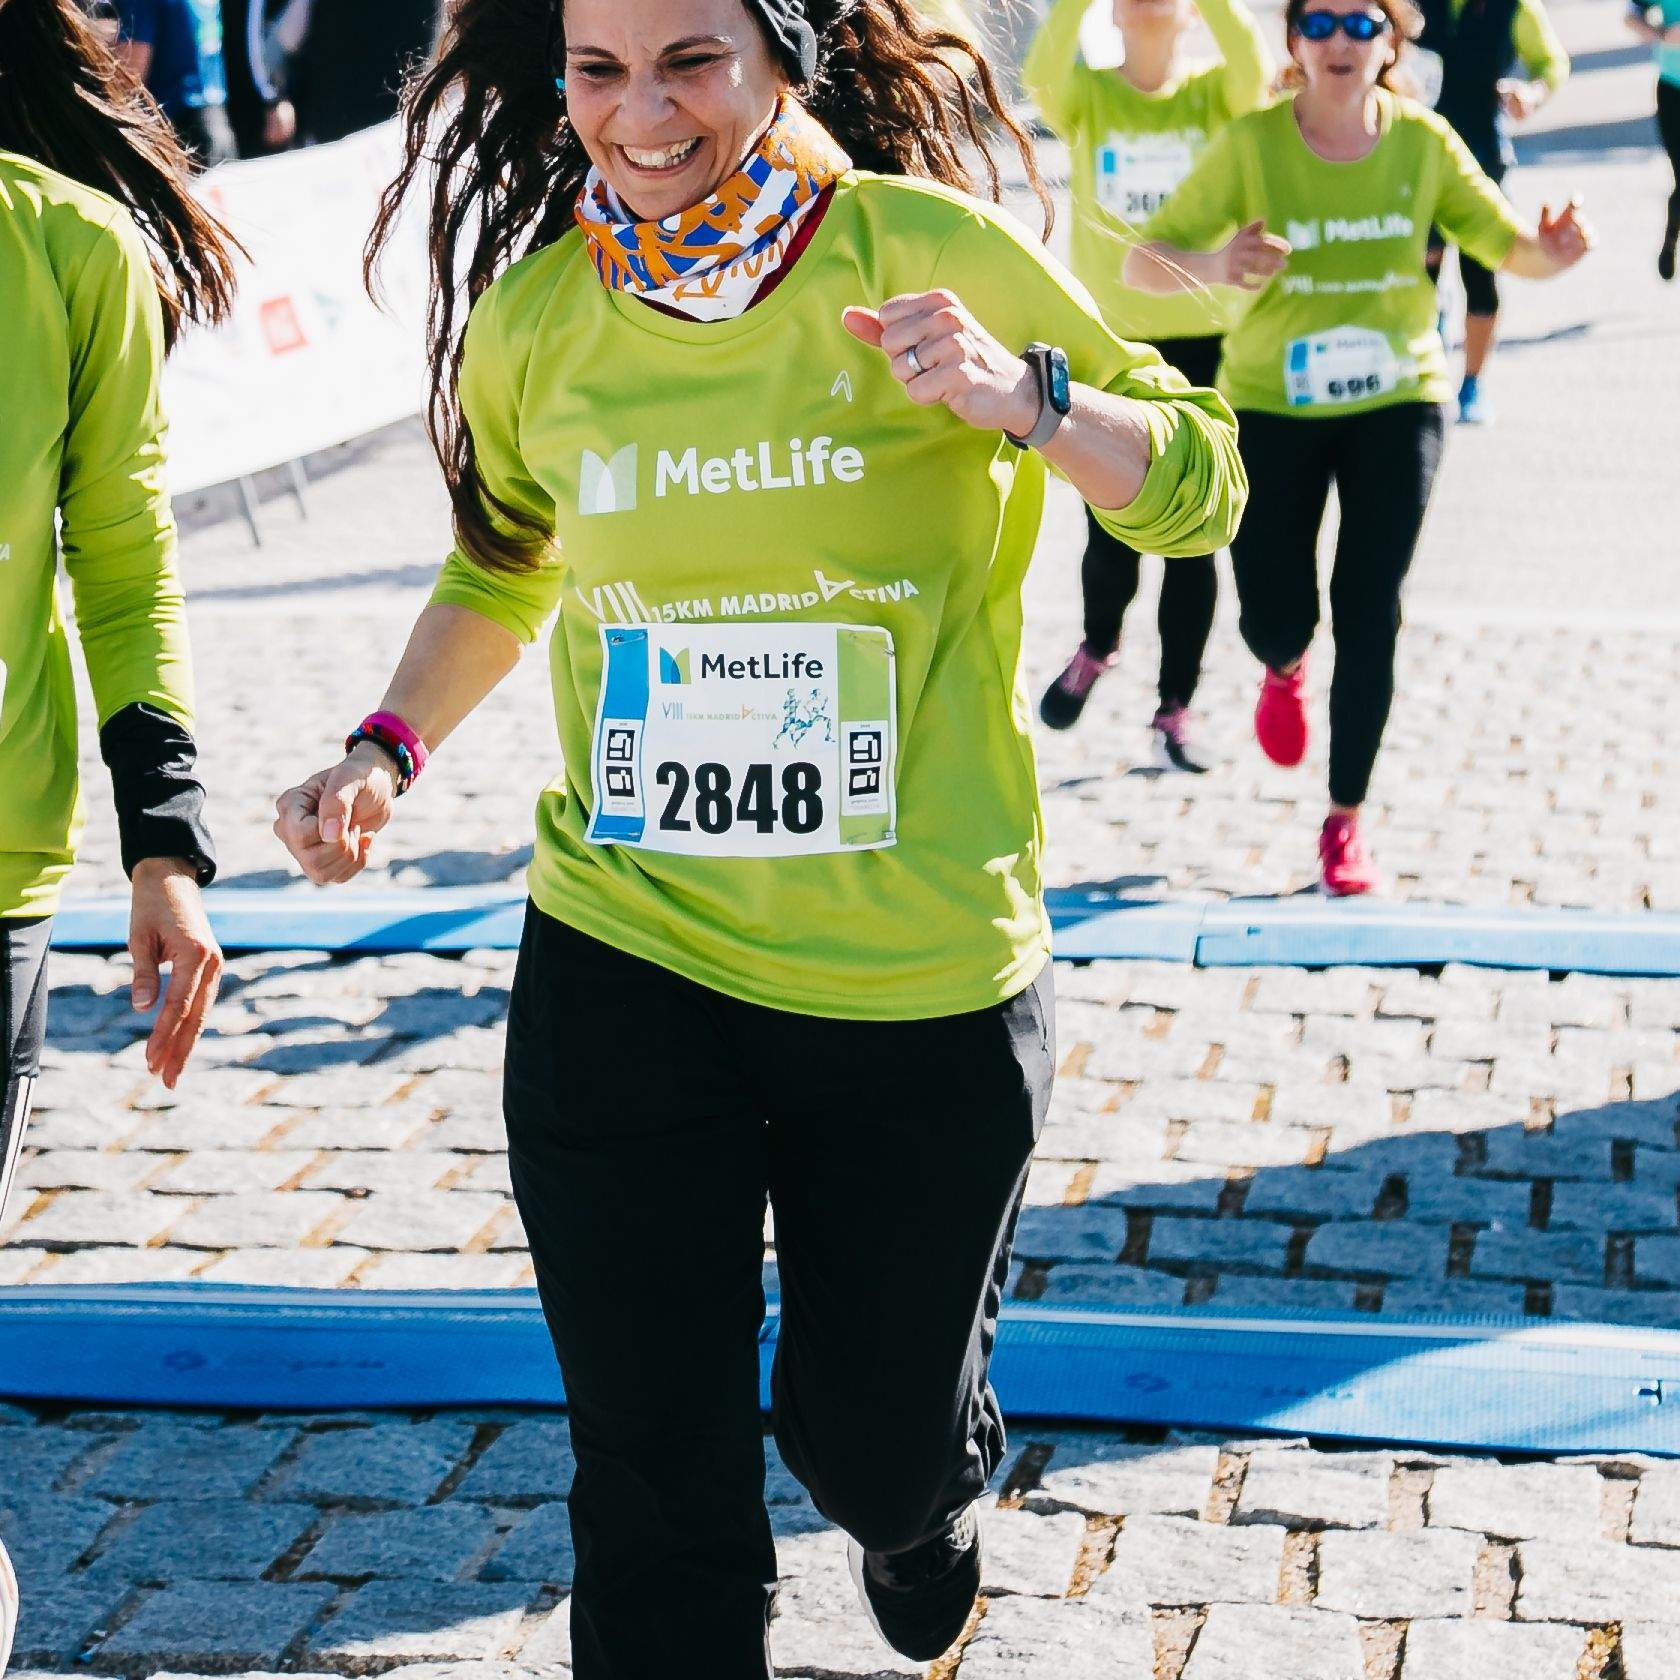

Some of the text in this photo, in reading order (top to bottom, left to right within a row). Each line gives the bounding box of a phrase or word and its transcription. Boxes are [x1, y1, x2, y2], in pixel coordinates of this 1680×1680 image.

[655, 436, 865, 497] MetLife
[651, 598, 714, 623] 15KM
[720, 591, 819, 617] MADRID
[701, 652, 824, 680] MetLife
[655, 761, 824, 835] 2848
